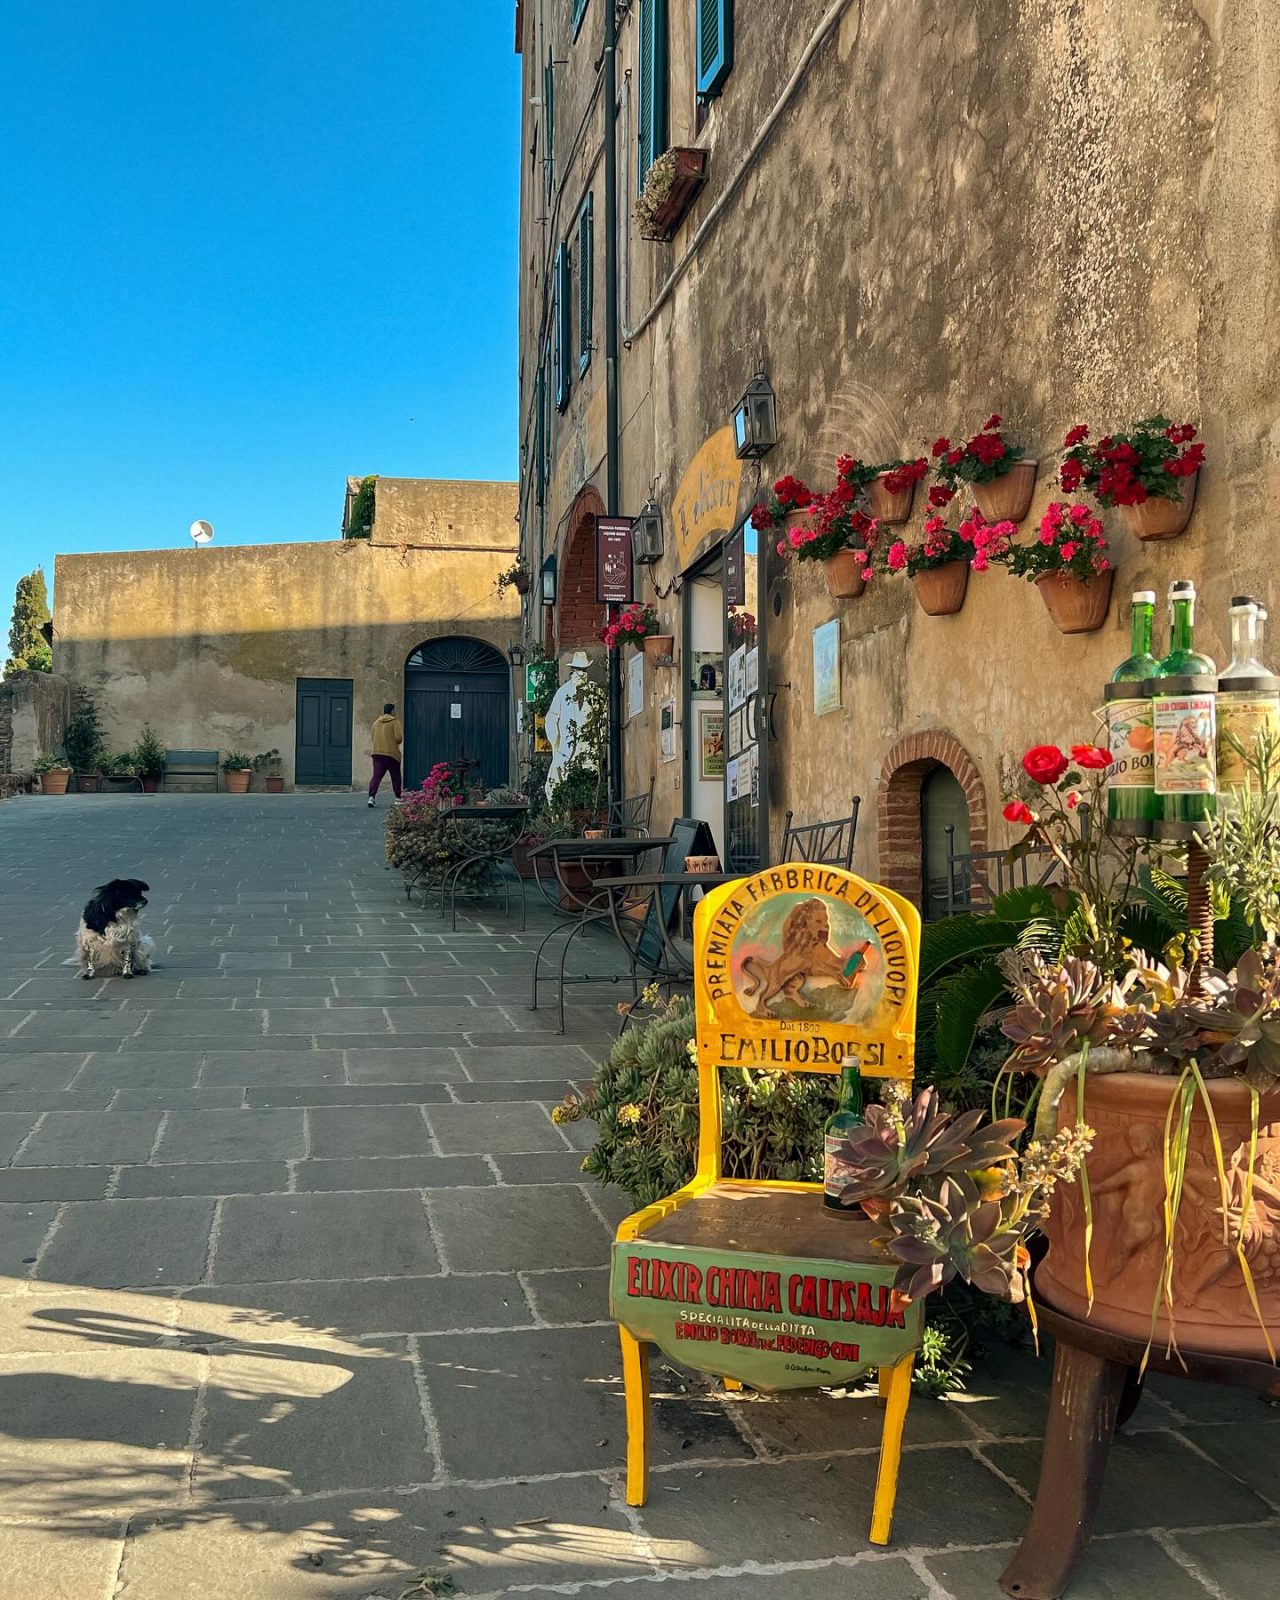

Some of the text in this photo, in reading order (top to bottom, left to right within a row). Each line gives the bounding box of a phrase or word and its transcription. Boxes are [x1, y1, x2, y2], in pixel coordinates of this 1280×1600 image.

[706, 869, 906, 1006] PREMIATA FABBRICA DI LIQUORI
[719, 1033, 810, 1063] EMILIO
[627, 1256, 703, 1305] ELIXIR
[706, 1265, 783, 1314] CHINA
[675, 1321, 719, 1342] EMILIO
[777, 1334, 831, 1359] FEDERICO
[830, 1341, 860, 1362] CINI
[781, 1321, 816, 1336] DITTA
